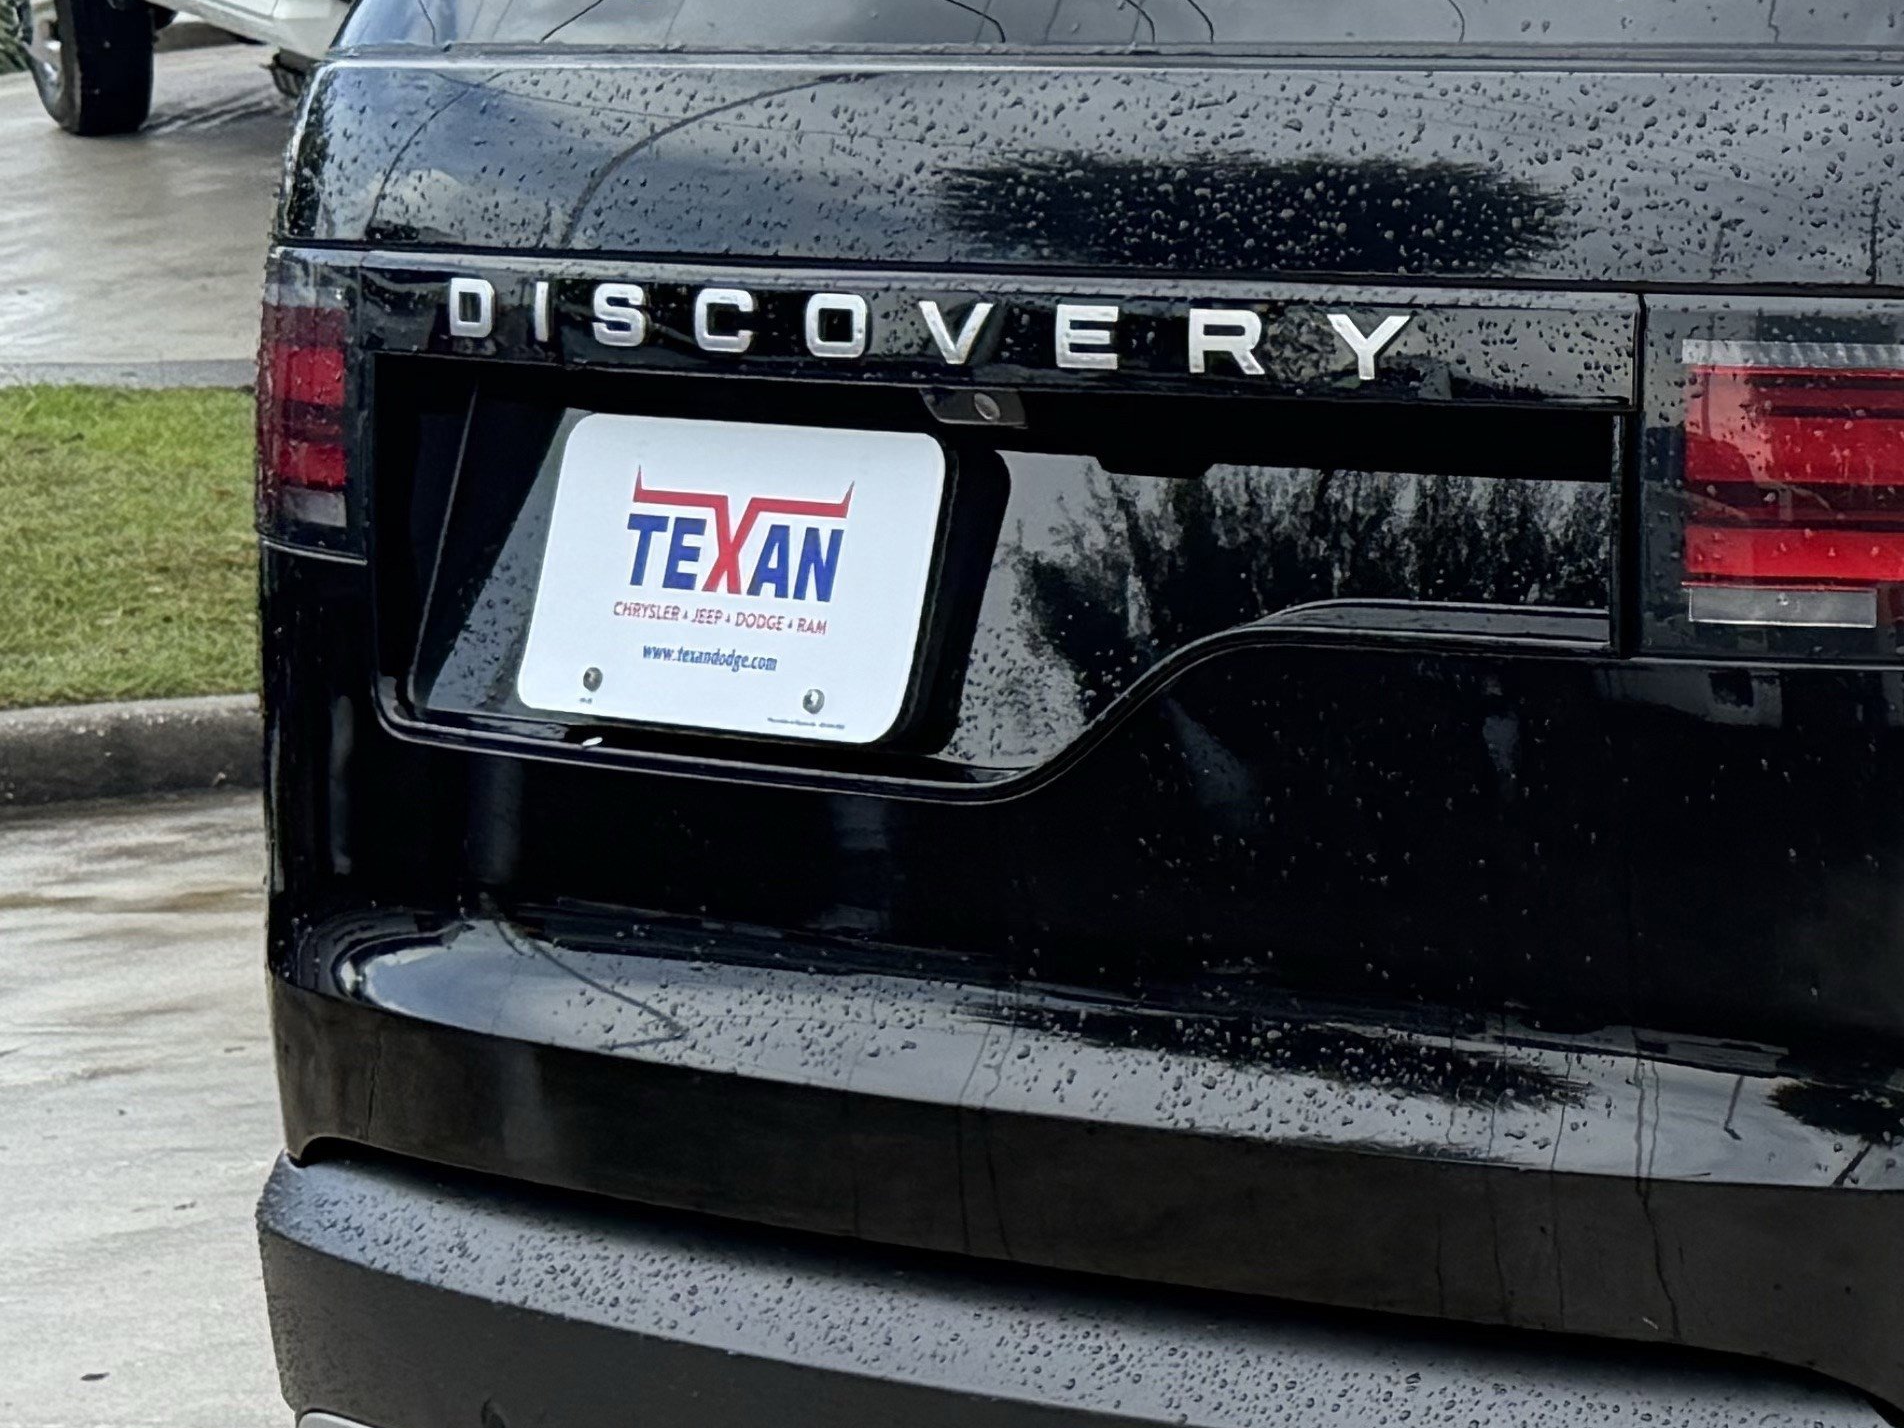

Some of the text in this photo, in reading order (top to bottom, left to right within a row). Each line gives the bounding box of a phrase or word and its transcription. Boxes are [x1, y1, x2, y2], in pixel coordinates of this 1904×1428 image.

[449, 277, 1410, 381] DISCOVERY
[627, 465, 855, 603] TEXAN
[613, 601, 828, 636] CHRYSLER JEEP DODGE RAM
[643, 645, 778, 672] www.texandodge.com
